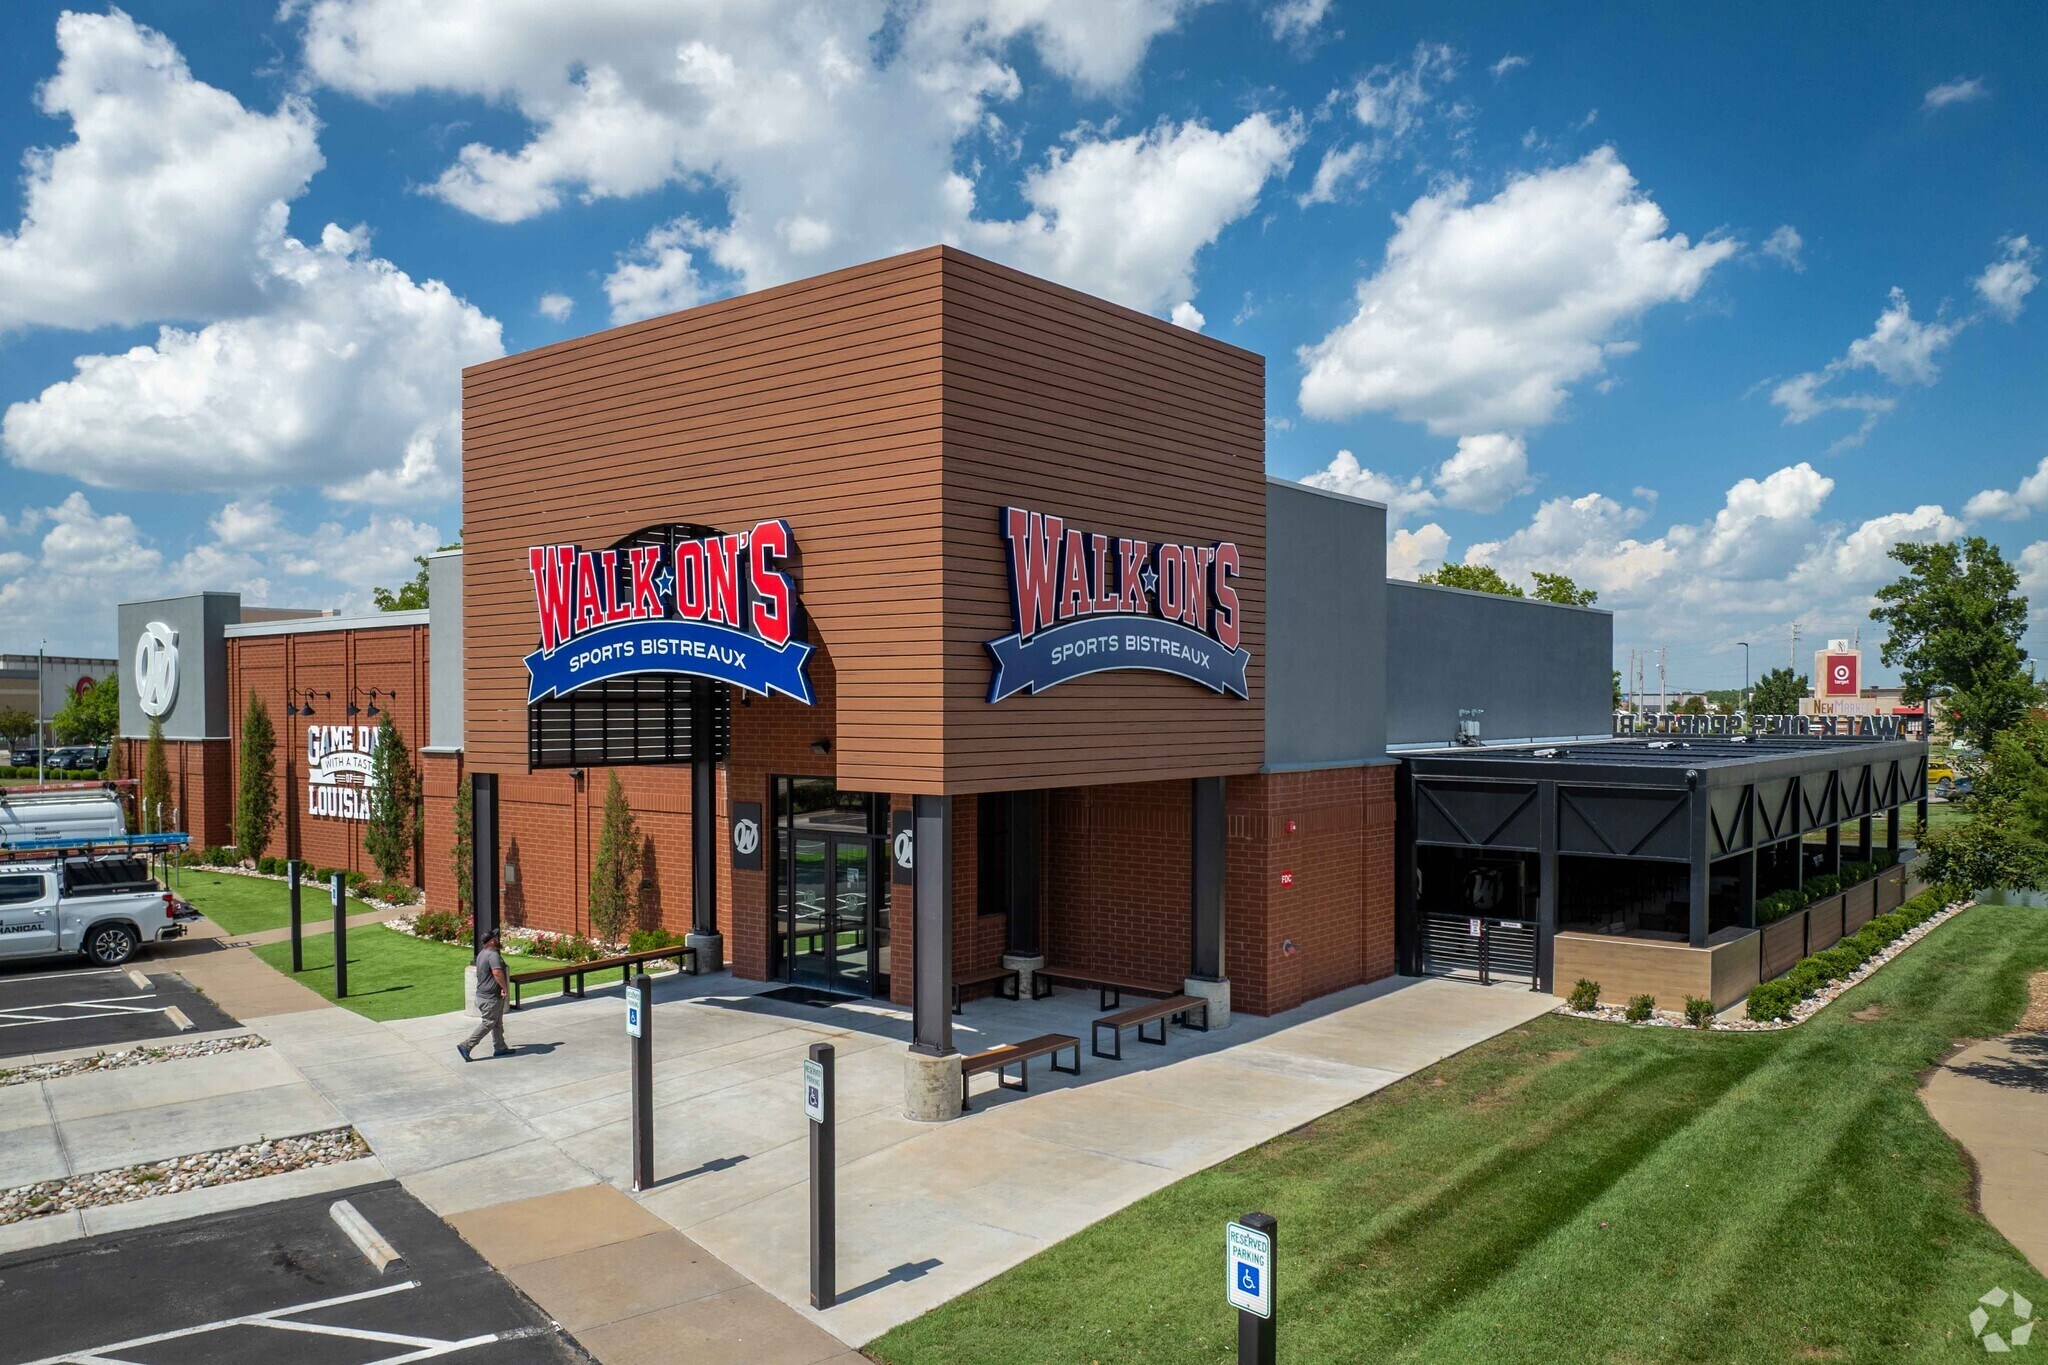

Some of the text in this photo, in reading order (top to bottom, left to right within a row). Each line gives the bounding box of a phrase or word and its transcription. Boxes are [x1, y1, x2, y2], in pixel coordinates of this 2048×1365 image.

[569, 637, 747, 673] SPORTS BISTREAUX
[1050, 634, 1211, 670] SPORTS BISTREAUX
[308, 725, 353, 765] GAME
[325, 757, 373, 771] WITH A TAST
[345, 774, 353, 783] OF
[1281, 874, 1292, 884] FDC
[1231, 1231, 1266, 1252] RESERVED
[1233, 1246, 1264, 1266] PARKING
